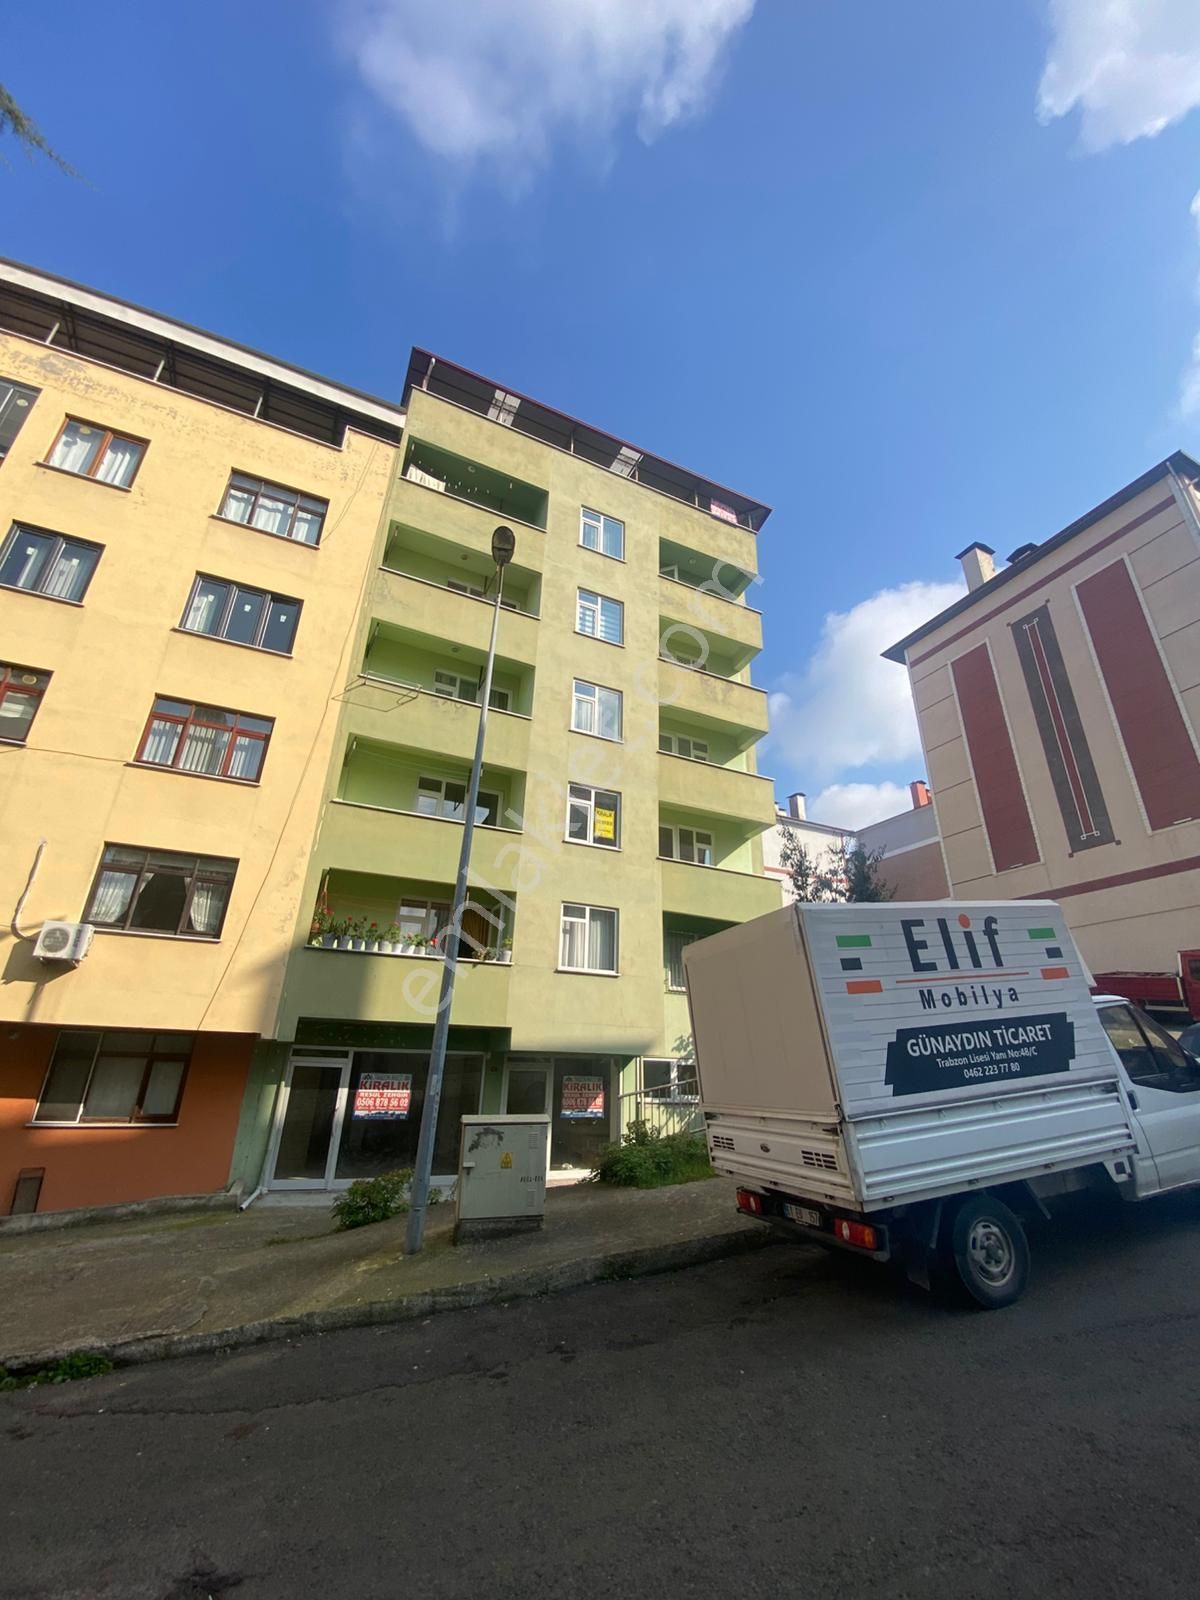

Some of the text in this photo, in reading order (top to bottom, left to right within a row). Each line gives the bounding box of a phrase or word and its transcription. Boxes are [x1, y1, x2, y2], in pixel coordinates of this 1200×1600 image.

[900, 913, 1004, 973] Elif
[918, 985, 1020, 1010] Mobilya
[907, 1024, 1052, 1057] GÜNAYDIN TİCARET
[936, 1056, 969, 1069] Trabzon
[969, 1051, 991, 1064] Lisesi
[991, 1050, 1008, 1061] Yanı
[963, 1066, 984, 1079] 0462
[984, 1065, 999, 1075] 223
[999, 1063, 1009, 1073] 77
[360, 1080, 410, 1090] KIRALIK
